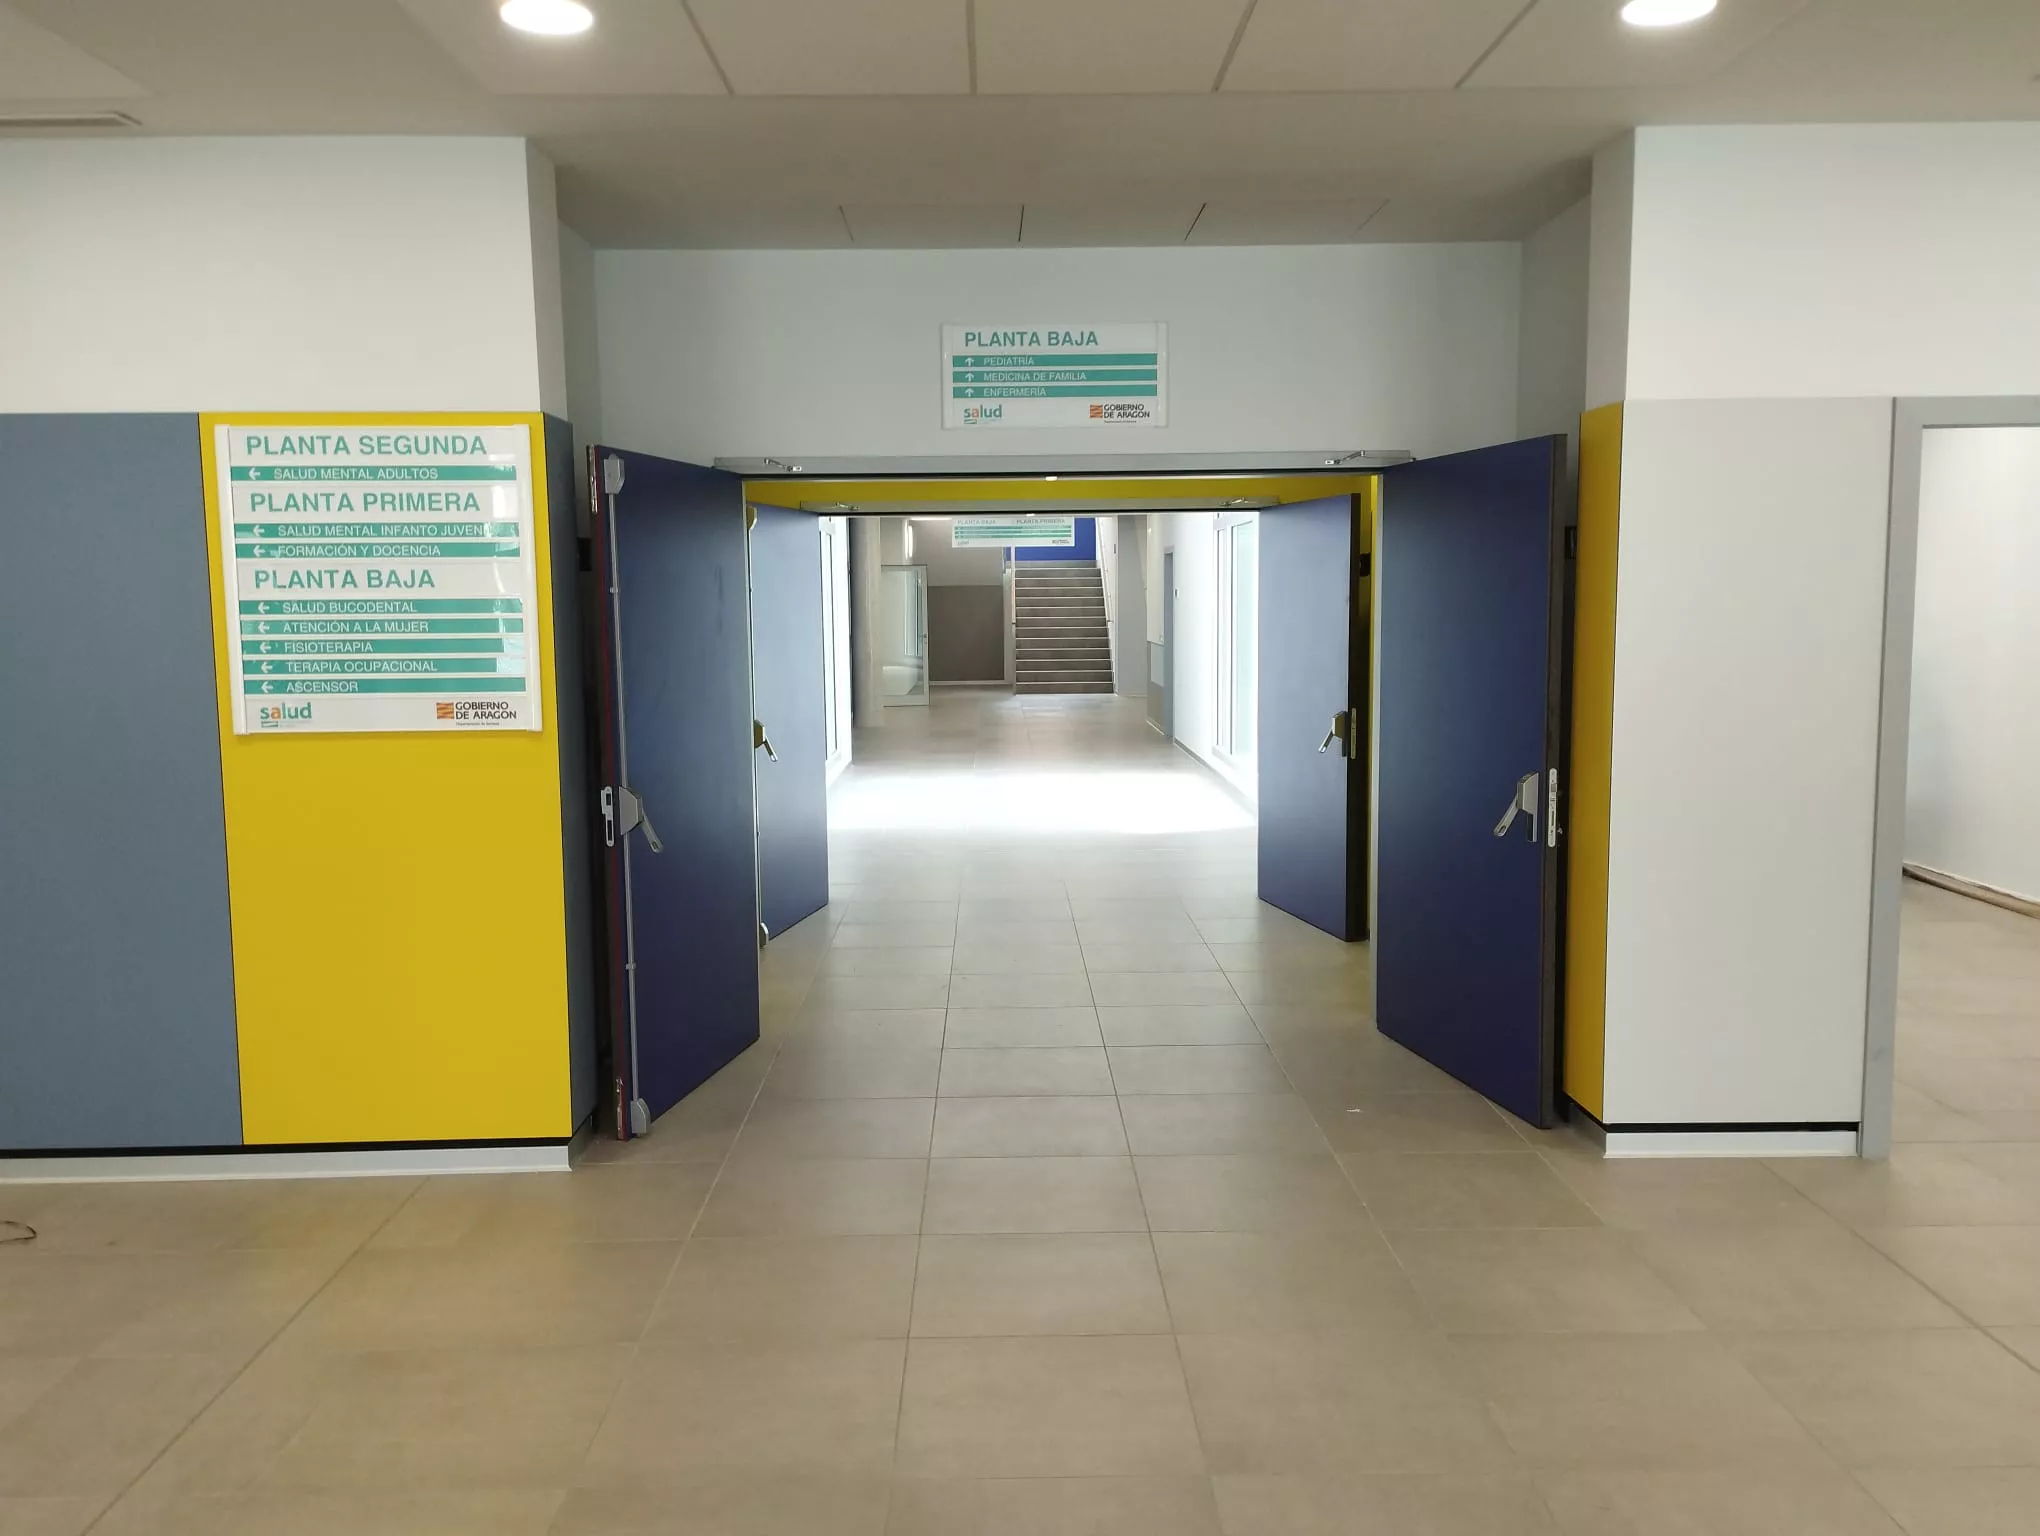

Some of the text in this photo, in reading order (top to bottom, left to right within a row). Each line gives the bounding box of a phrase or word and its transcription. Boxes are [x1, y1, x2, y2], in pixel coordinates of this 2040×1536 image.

[964, 330, 1099, 347] PLANTA BAJA
[983, 371, 1087, 382] MEDICINA DE FAMILIA
[963, 404, 1003, 418] salud
[1103, 404, 1145, 412] GOBIERNO
[1103, 411, 1115, 419] DE
[245, 434, 488, 456] PLANTA SEGUNDA
[273, 467, 439, 481] SALUD MENTAL ADULTOS
[250, 491, 481, 513] PLANTA PRIMERA
[278, 524, 493, 537] SALUD MENTAL INFANTO JUVEN
[277, 543, 441, 557] FORMACIÓN Y DOCENCIA
[254, 569, 436, 589] PLANTA BAJA
[283, 601, 418, 614] SALUD BUCODENTAL
[283, 620, 429, 633] ATENCIÓN A LA MUJER
[284, 641, 373, 653] FISIOTERAPIA
[286, 660, 438, 673] TERAPIA OCUPACIONAL
[286, 681, 359, 693] ASCENSOR
[260, 702, 312, 720] salud
[455, 701, 509, 710] GOBIERNO
[455, 711, 517, 720] DE ARAGON
